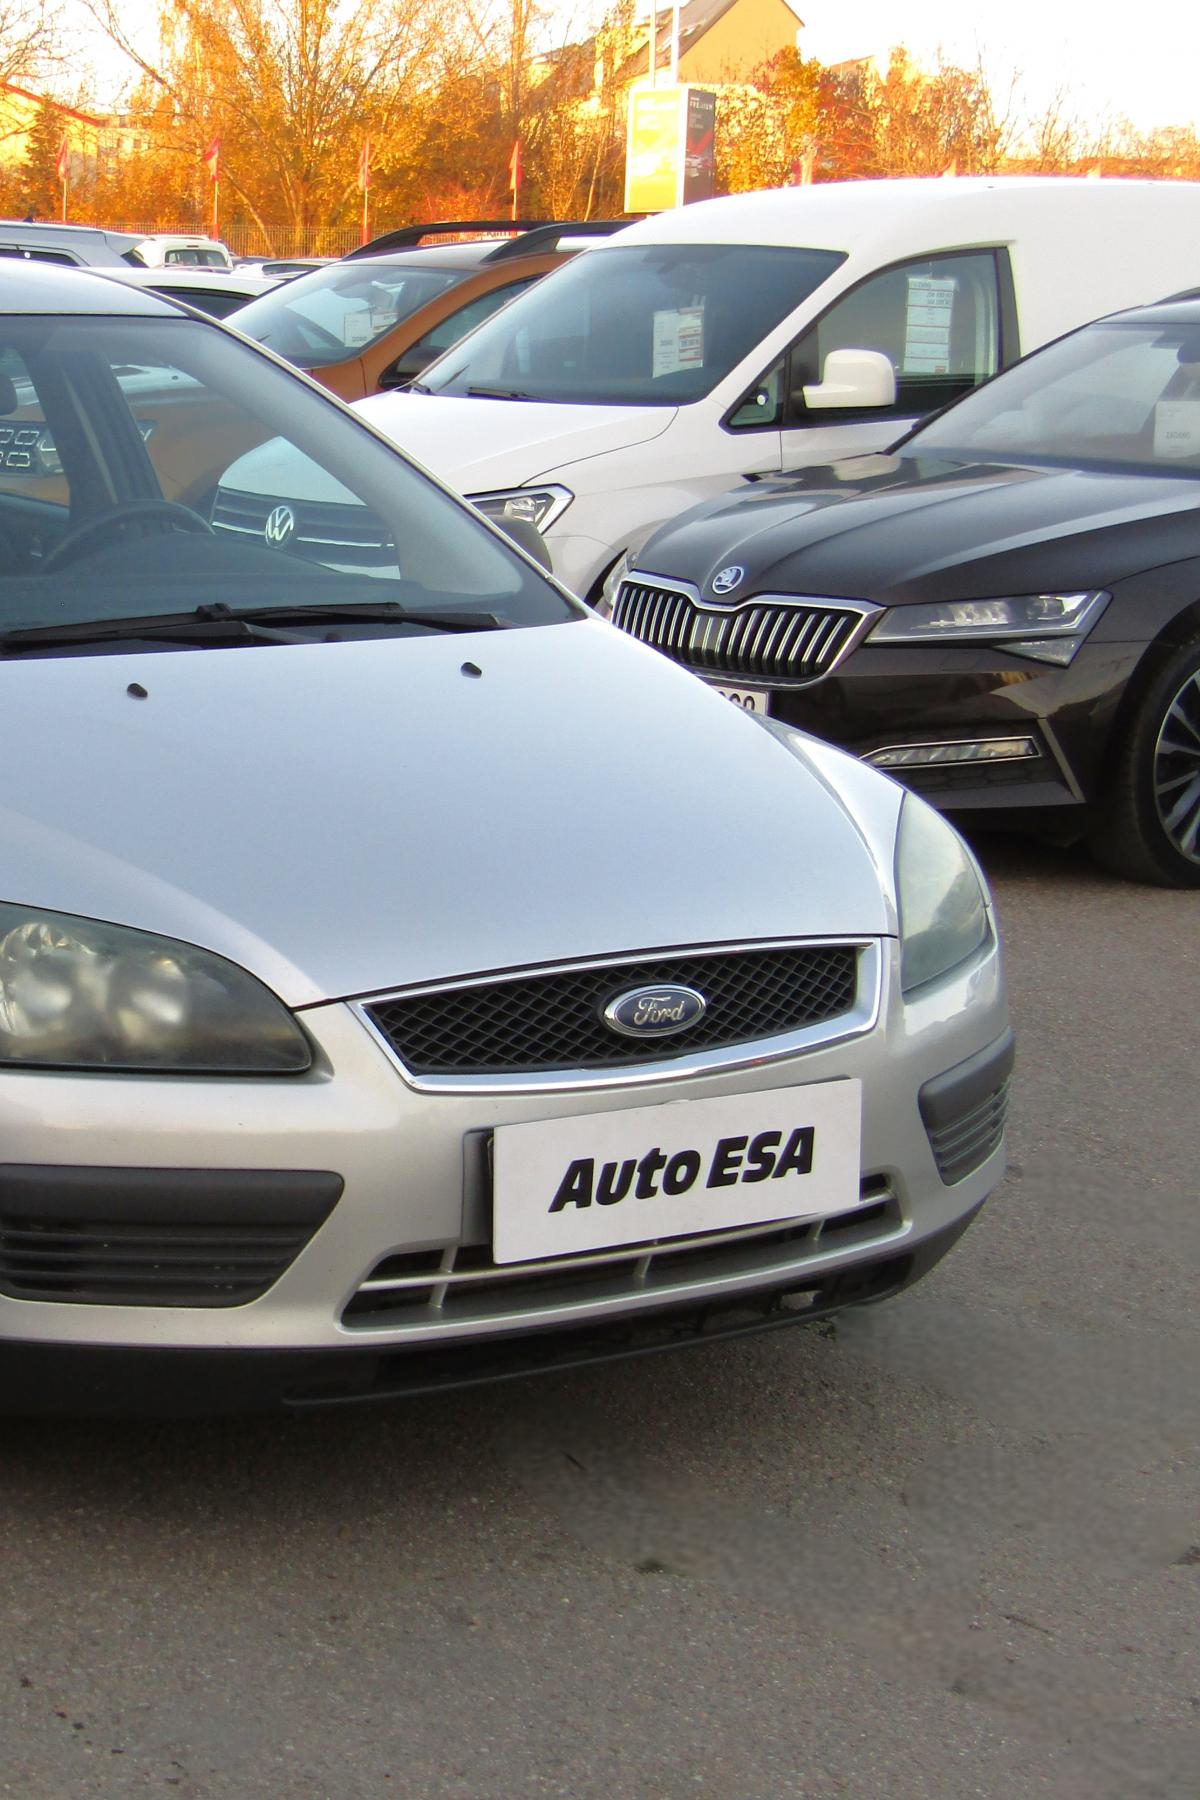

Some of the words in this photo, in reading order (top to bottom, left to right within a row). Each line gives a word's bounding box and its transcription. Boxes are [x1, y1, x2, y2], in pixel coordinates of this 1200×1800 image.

[633, 996, 686, 1025] Ford
[548, 1147, 701, 1213] Auto
[706, 1126, 815, 1188] ESA
